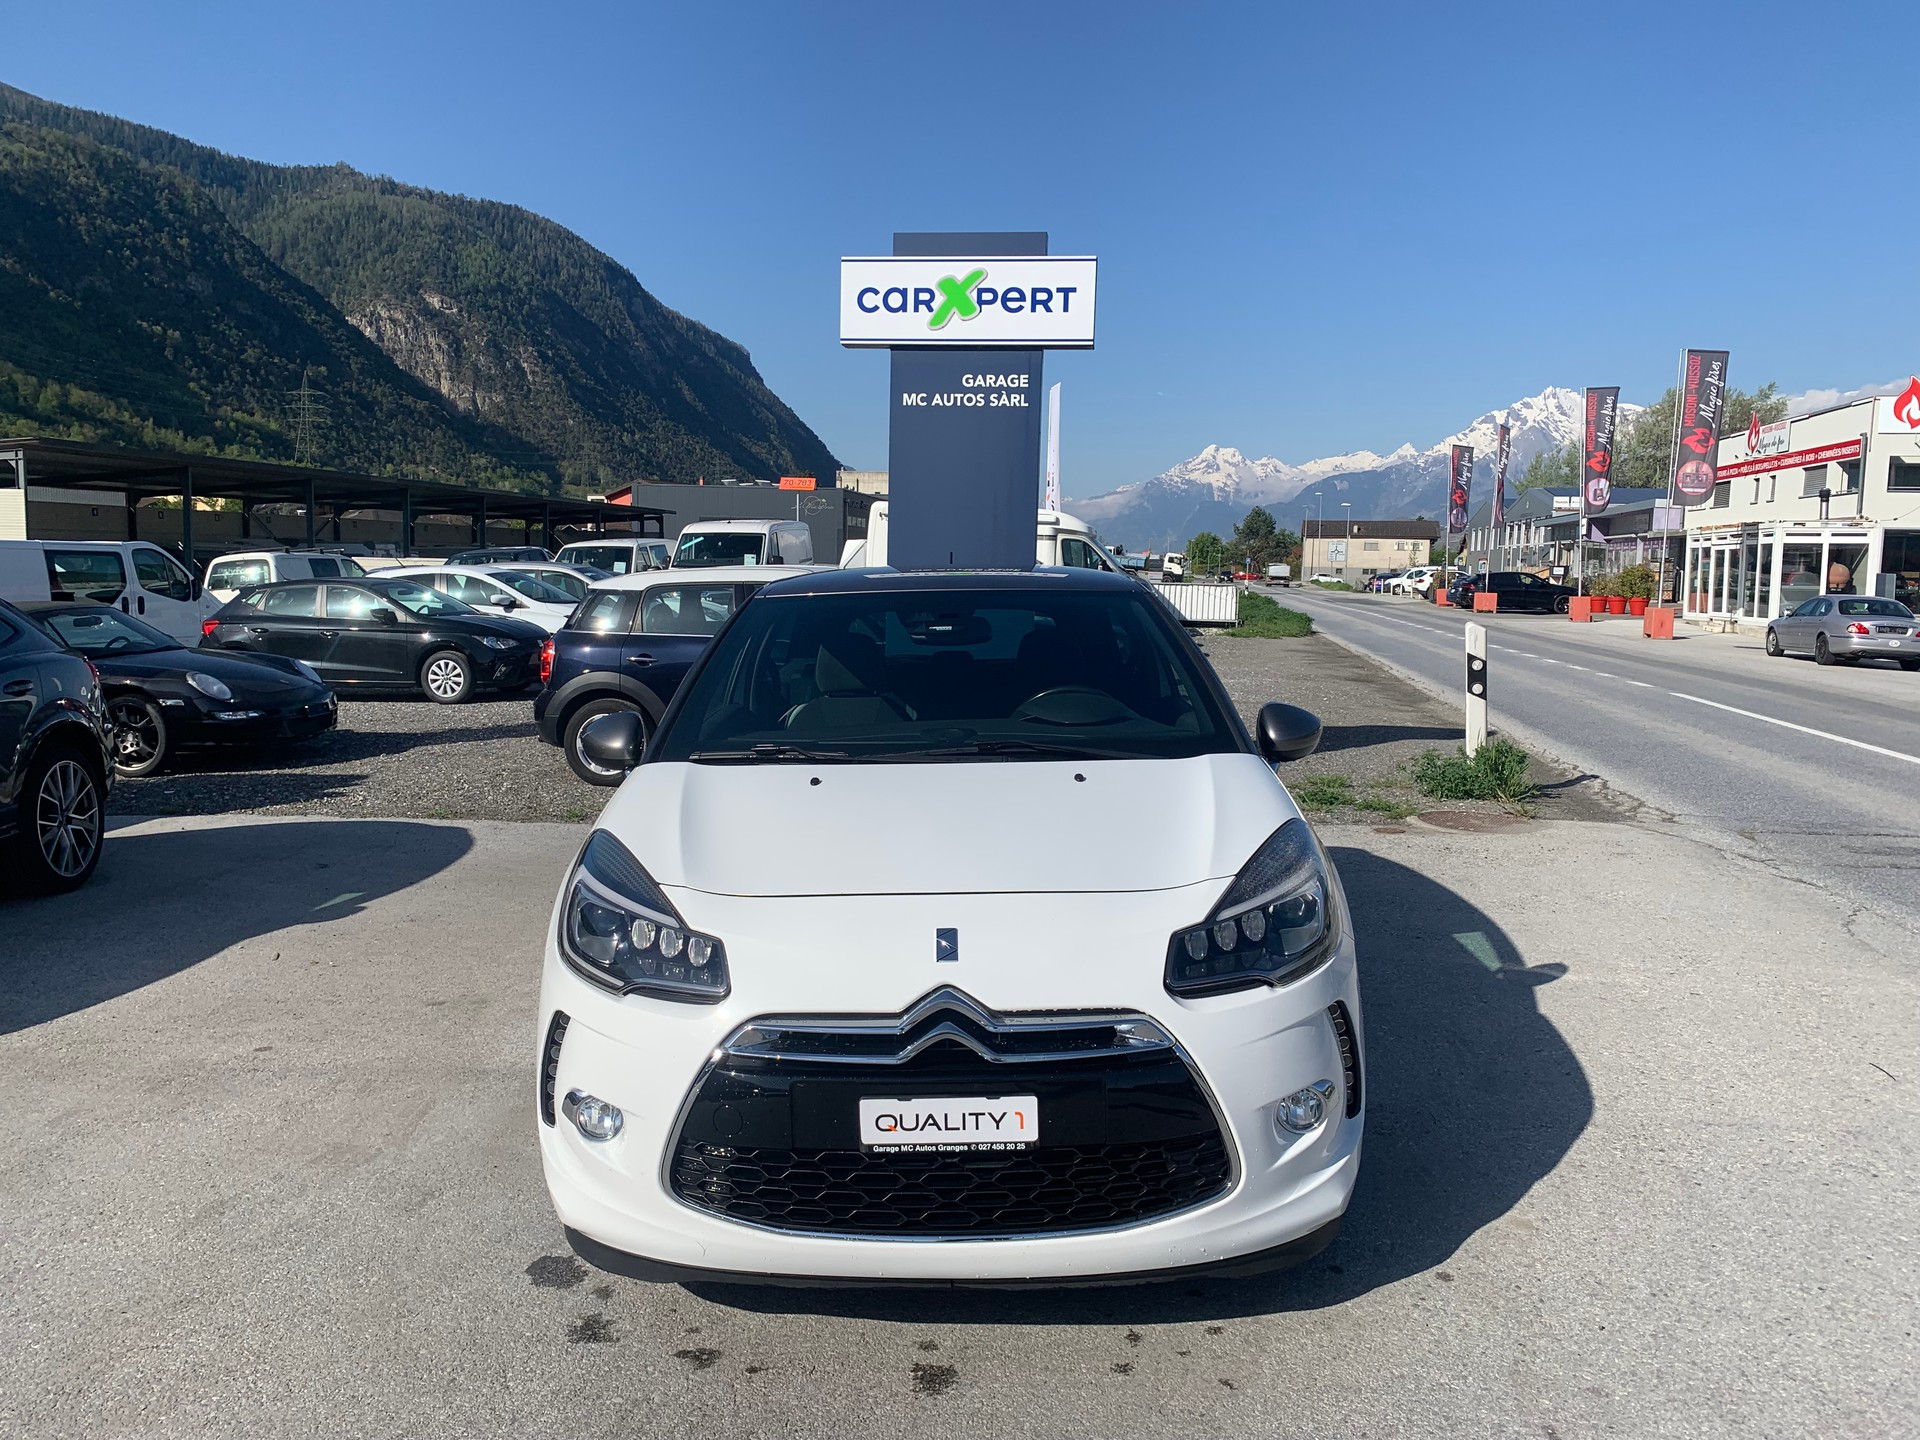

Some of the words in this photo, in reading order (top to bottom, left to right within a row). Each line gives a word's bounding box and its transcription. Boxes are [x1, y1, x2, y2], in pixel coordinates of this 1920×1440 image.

[962, 374, 1029, 388] GARAGE
[1705, 360, 1725, 388] fires
[902, 393, 927, 406] MC
[932, 393, 985, 407] AUTOS
[990, 391, 1029, 407] SÀRL
[1684, 354, 1701, 427] MOSONI-VUISSOZ
[1601, 395, 1615, 416] fires
[1699, 386, 1723, 429] Magic
[1587, 393, 1598, 451] MOSONI-VUISSOZ
[1597, 416, 1614, 450] Magic
[875, 1112, 1007, 1131] QUALITY
[1014, 1111, 1024, 1129] 1
[937, 1143, 968, 1152] Granges
